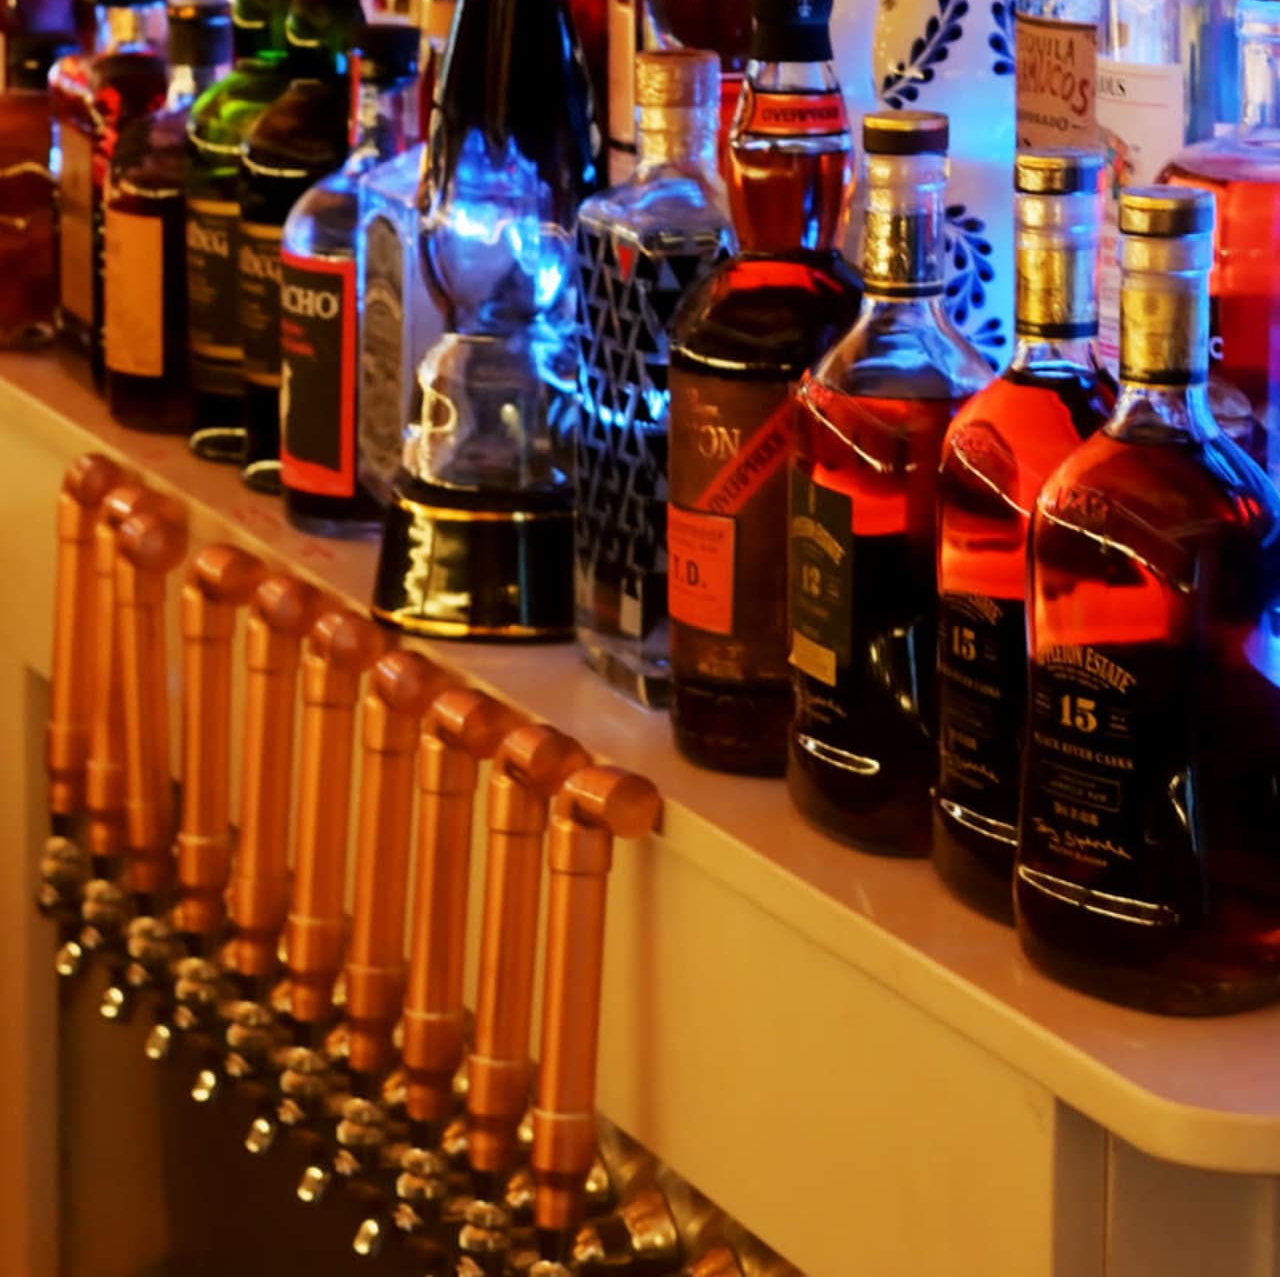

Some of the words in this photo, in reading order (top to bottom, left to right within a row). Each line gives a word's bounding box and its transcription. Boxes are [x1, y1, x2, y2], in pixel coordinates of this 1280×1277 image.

[281, 285, 340, 319] CHO
[951, 624, 977, 661] 15
[1061, 693, 1098, 733] 15
